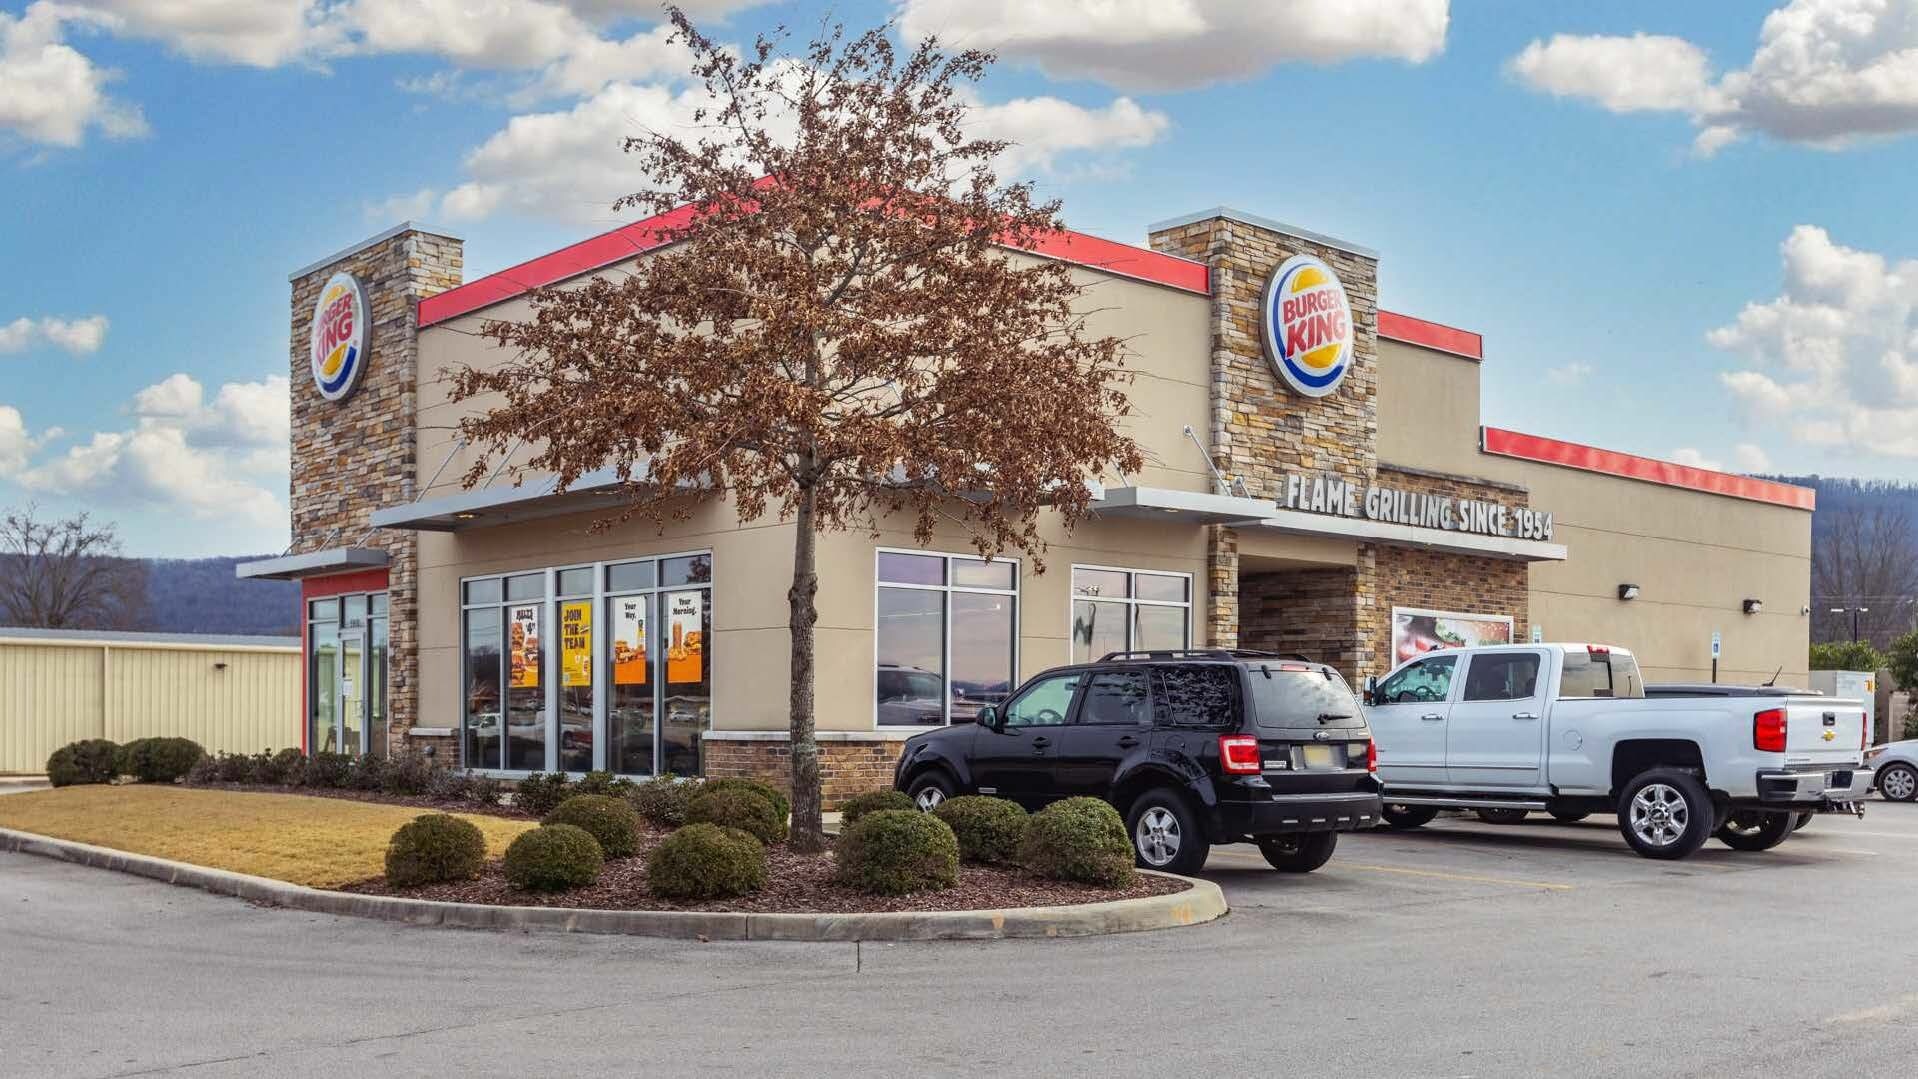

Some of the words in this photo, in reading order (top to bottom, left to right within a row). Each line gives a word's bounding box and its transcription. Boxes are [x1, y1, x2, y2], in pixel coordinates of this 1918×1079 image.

[1283, 288, 1343, 324] BURGER
[317, 291, 353, 336] RGER
[1286, 310, 1346, 358] KING
[1287, 475, 1356, 515] FLAME
[1365, 486, 1452, 530] GRILLING
[1459, 499, 1507, 536] SINCE
[1514, 509, 1554, 542] 1954
[624, 602, 637, 611] Your
[678, 598, 691, 606] Your
[563, 608, 582, 622] JOIN
[564, 623, 580, 636] THE
[564, 637, 585, 650] TEAM
